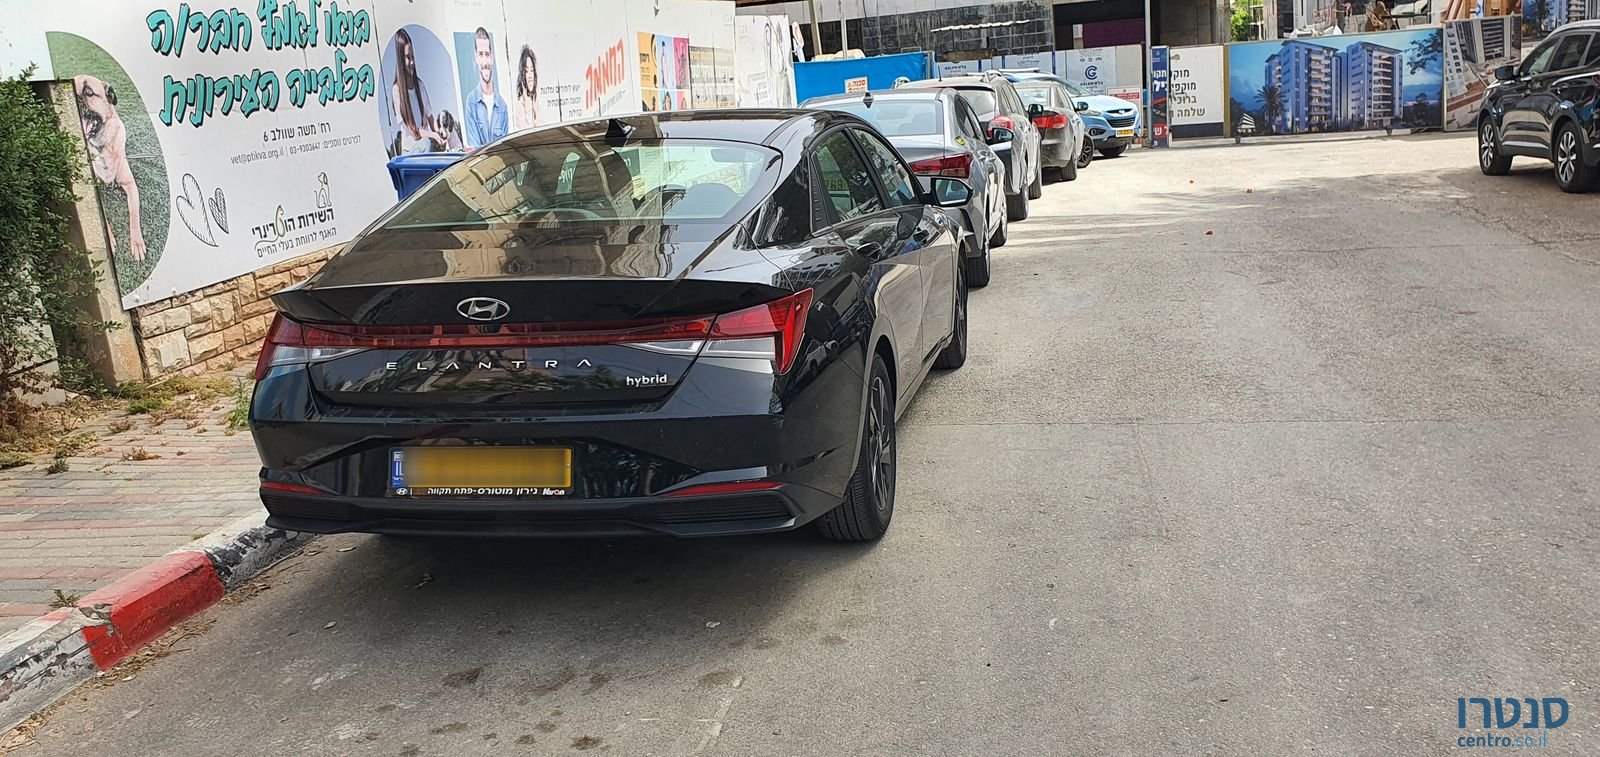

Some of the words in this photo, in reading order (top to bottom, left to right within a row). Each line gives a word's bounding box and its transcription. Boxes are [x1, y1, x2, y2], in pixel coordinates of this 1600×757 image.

[146, 3, 252, 58] חבר/ה
[256, 0, 322, 51] לאמץ
[324, 1, 371, 48] בואו
[285, 48, 375, 107] בכלבייה
[1170, 69, 1190, 81] מוק
[1171, 82, 1197, 93] מוקפי
[159, 69, 280, 127] העירונית
[1177, 107, 1205, 118] שלמה
[263, 131, 269, 142] 6
[271, 127, 295, 141] שוולב
[297, 124, 317, 137] משה
[342, 135, 361, 145] לפרטים
[231, 147, 284, 164] vet@ptikva.org.il
[297, 208, 335, 229] השירות
[295, 232, 317, 247] לרווחת
[319, 227, 337, 241] האגף
[257, 244, 278, 258] החיים
[278, 239, 294, 251] בעלי
[386, 358, 592, 370] ELANTRA
[626, 374, 668, 387] hybrid
[427, 488, 452, 496] תקווה
[516, 488, 538, 496] נירון
